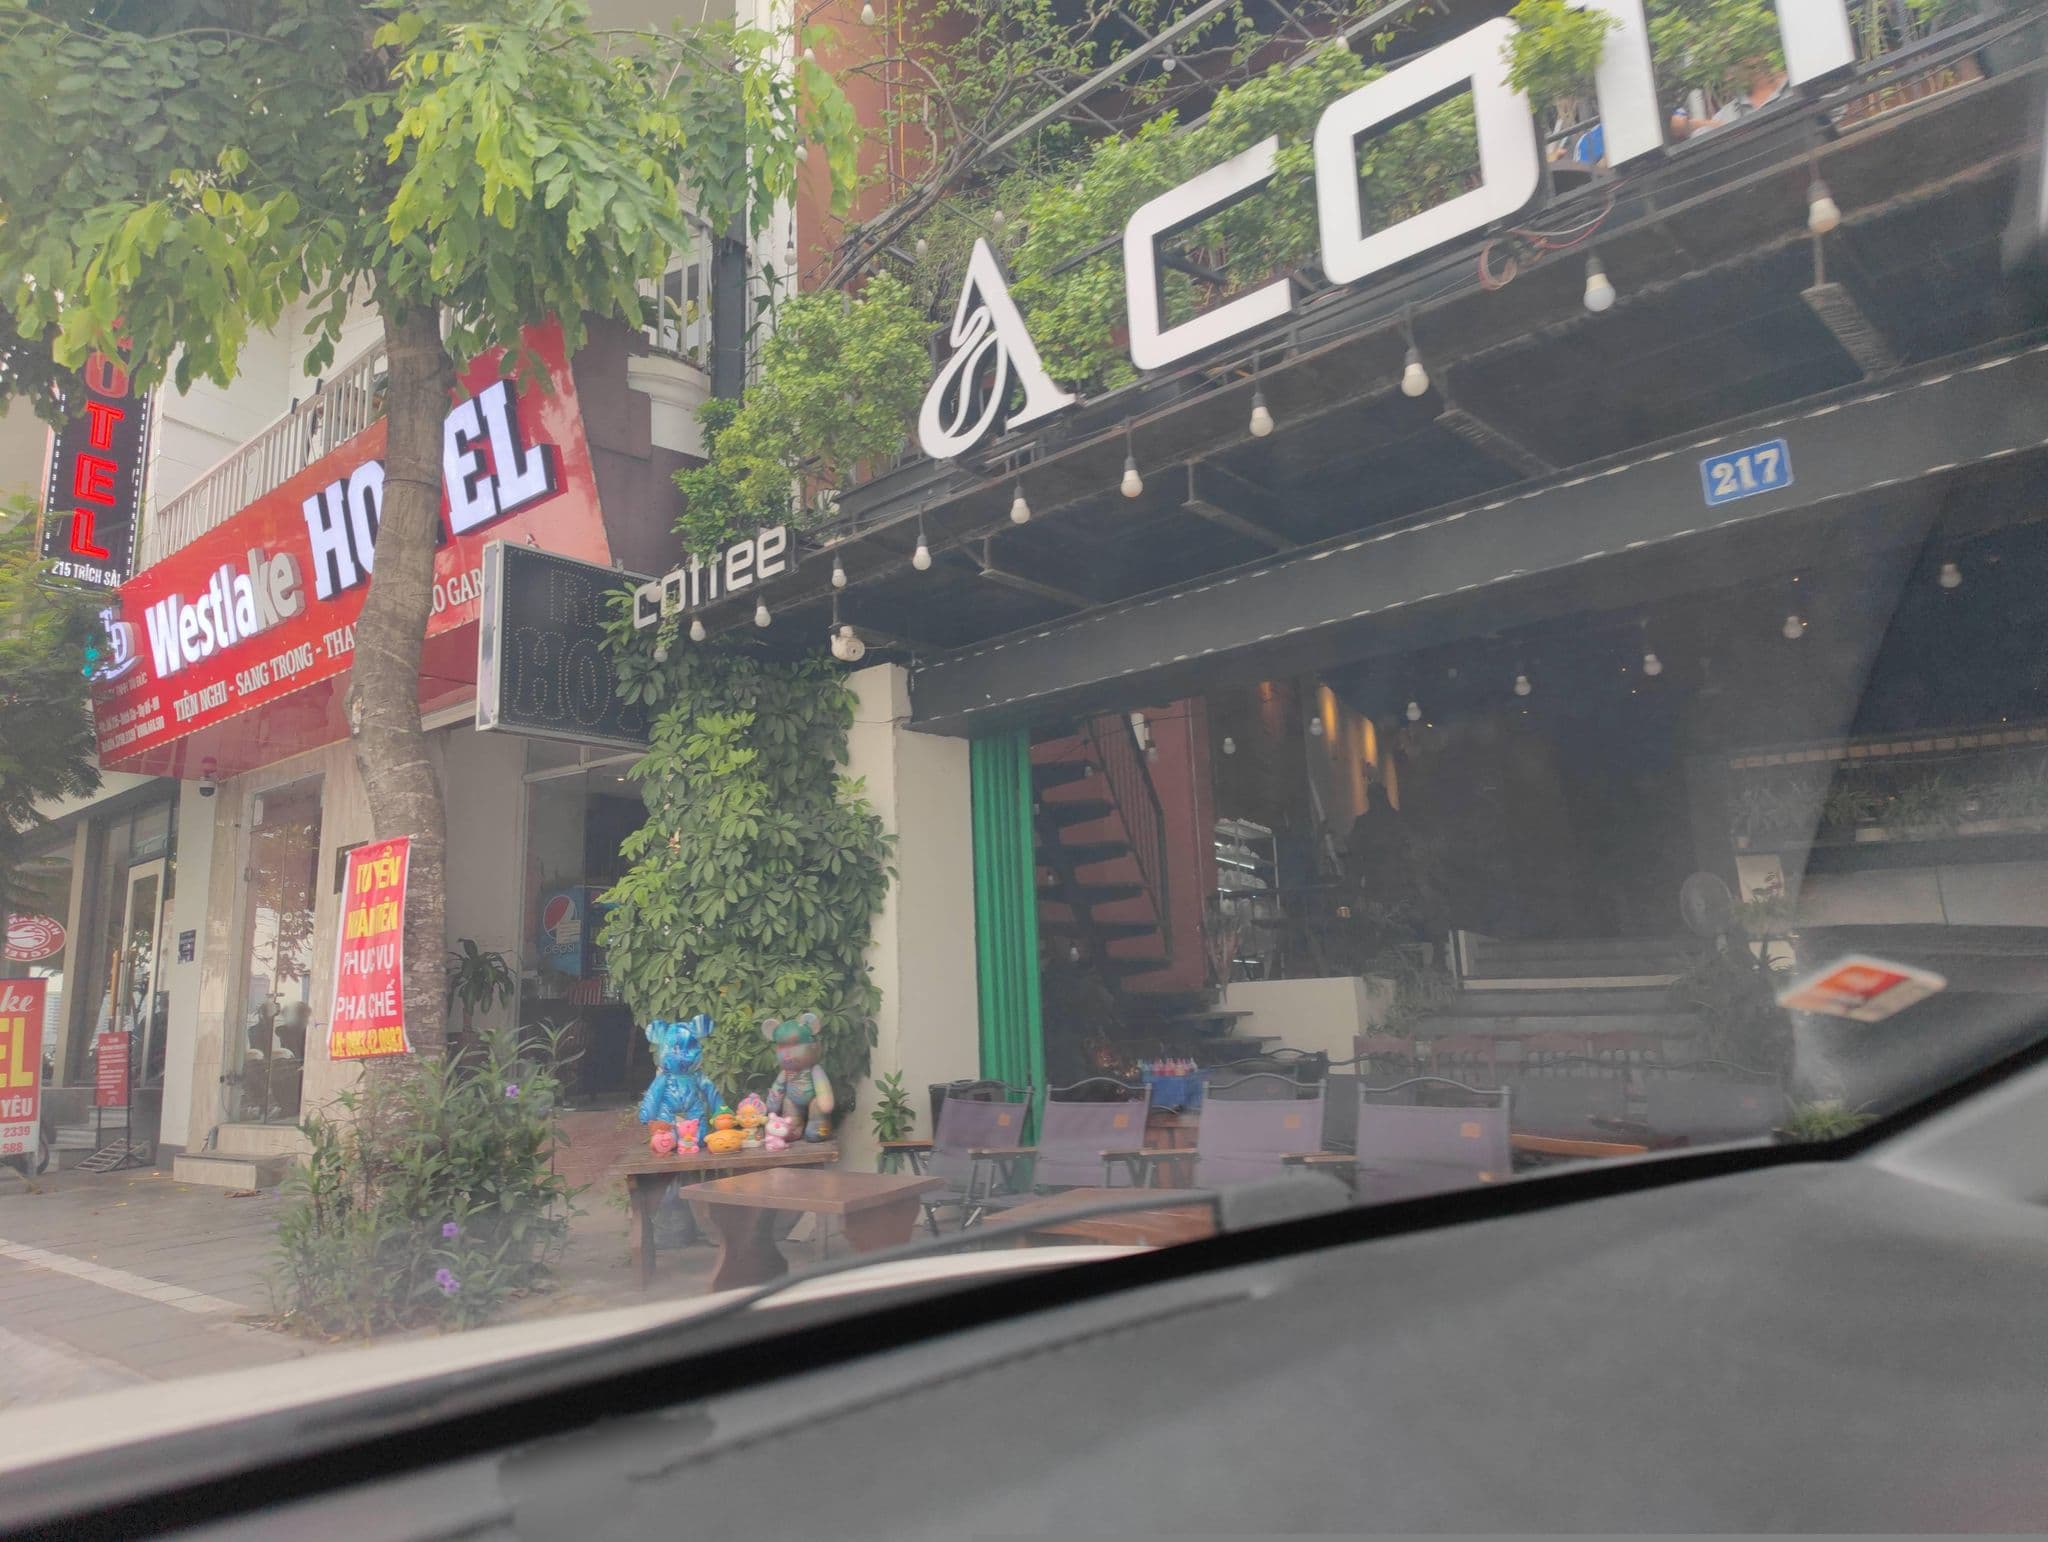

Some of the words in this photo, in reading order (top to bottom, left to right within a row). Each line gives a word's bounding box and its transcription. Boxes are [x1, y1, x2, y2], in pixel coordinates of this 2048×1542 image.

[70, 316, 136, 560] OTEL
[302, 379, 555, 601] HOEL
[1711, 448, 1779, 496] 217
[73, 563, 102, 584] TRÍCH
[144, 548, 304, 679] Westlake
[173, 689, 199, 723] TIỆN
[198, 680, 229, 706] NGHI
[235, 662, 270, 697] SANG
[270, 642, 314, 681] TRỌNG
[323, 621, 359, 658] THA
[429, 572, 446, 616] Ó
[376, 943, 395, 975] VỤ
[335, 993, 366, 1021] PHA
[367, 977, 398, 1018] CHẾ
[1, 1095, 33, 1118] YÊU
[3, 1126, 31, 1138] 2339
